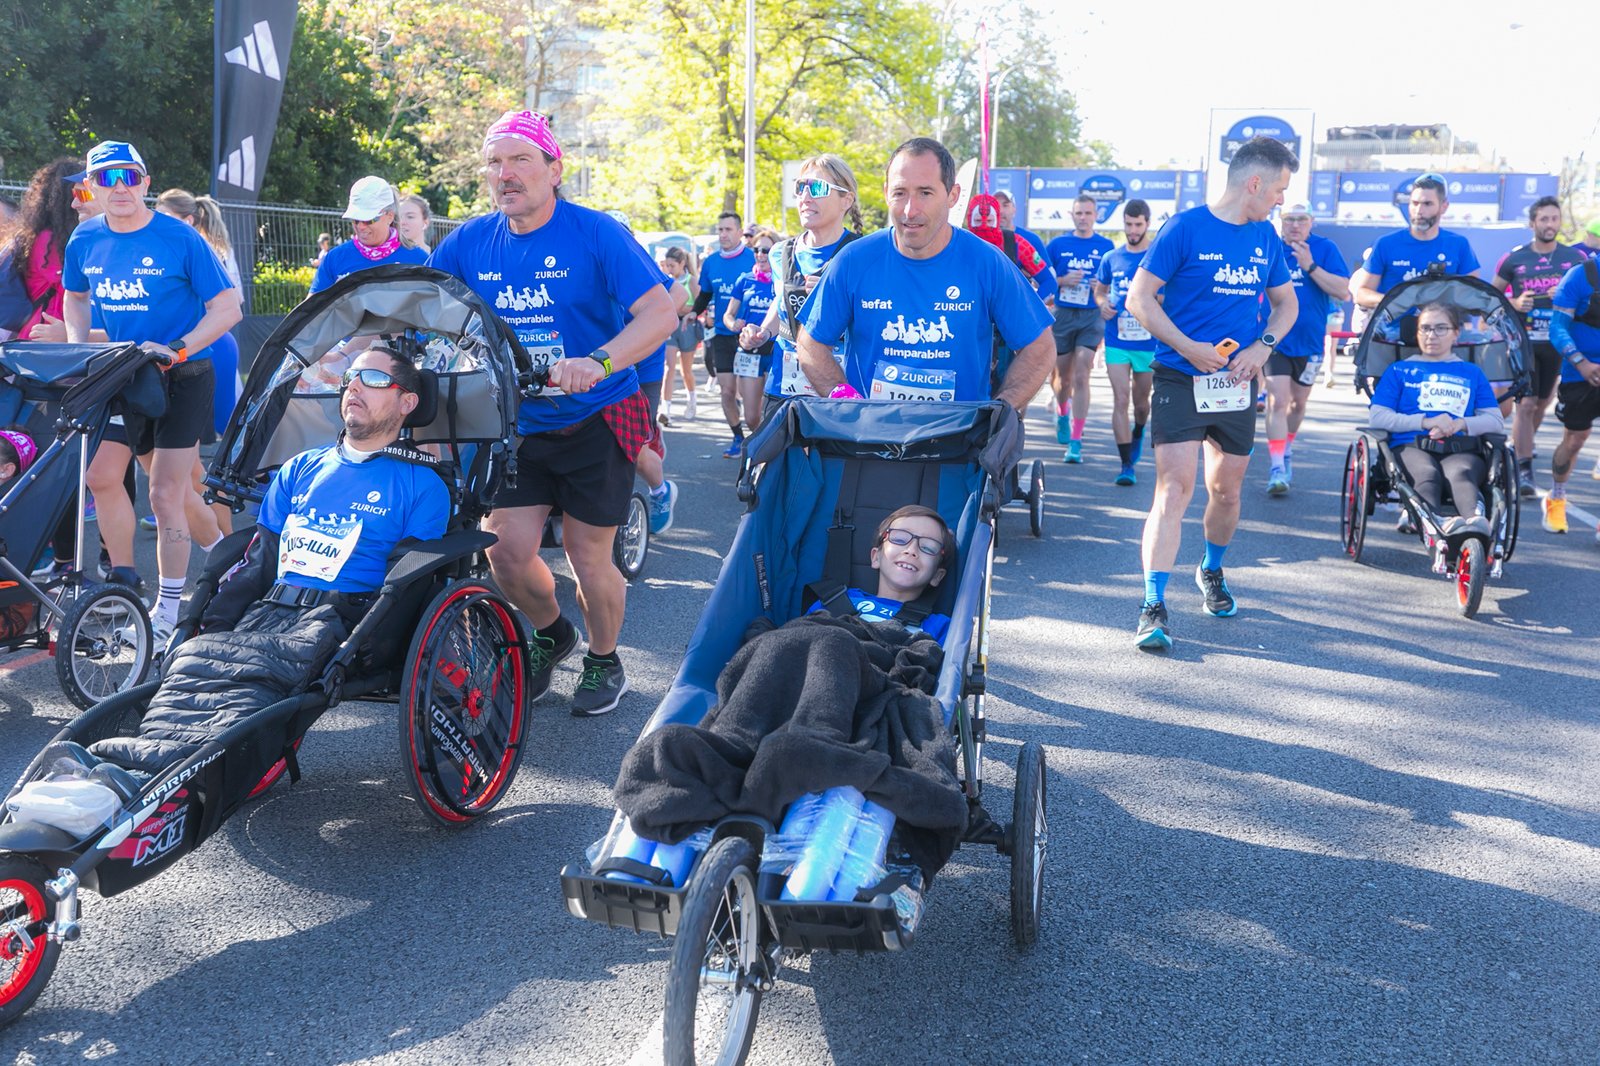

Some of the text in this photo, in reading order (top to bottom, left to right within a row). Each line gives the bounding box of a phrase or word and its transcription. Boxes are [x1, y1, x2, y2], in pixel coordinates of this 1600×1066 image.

[133, 267, 162, 275] ZURICH
[478, 272, 502, 281] aefat
[535, 270, 567, 279] ZURICH
[861, 298, 892, 310] aefat
[934, 302, 972, 311] ZURICH
[518, 333, 551, 343] ZURICH
[883, 347, 951, 359] #Imparables
[902, 372, 943, 384] ZURICH
[1429, 387, 1462, 399] CARMEN
[350, 502, 387, 516] ZURICH
[311, 524, 352, 536] ZURICH
